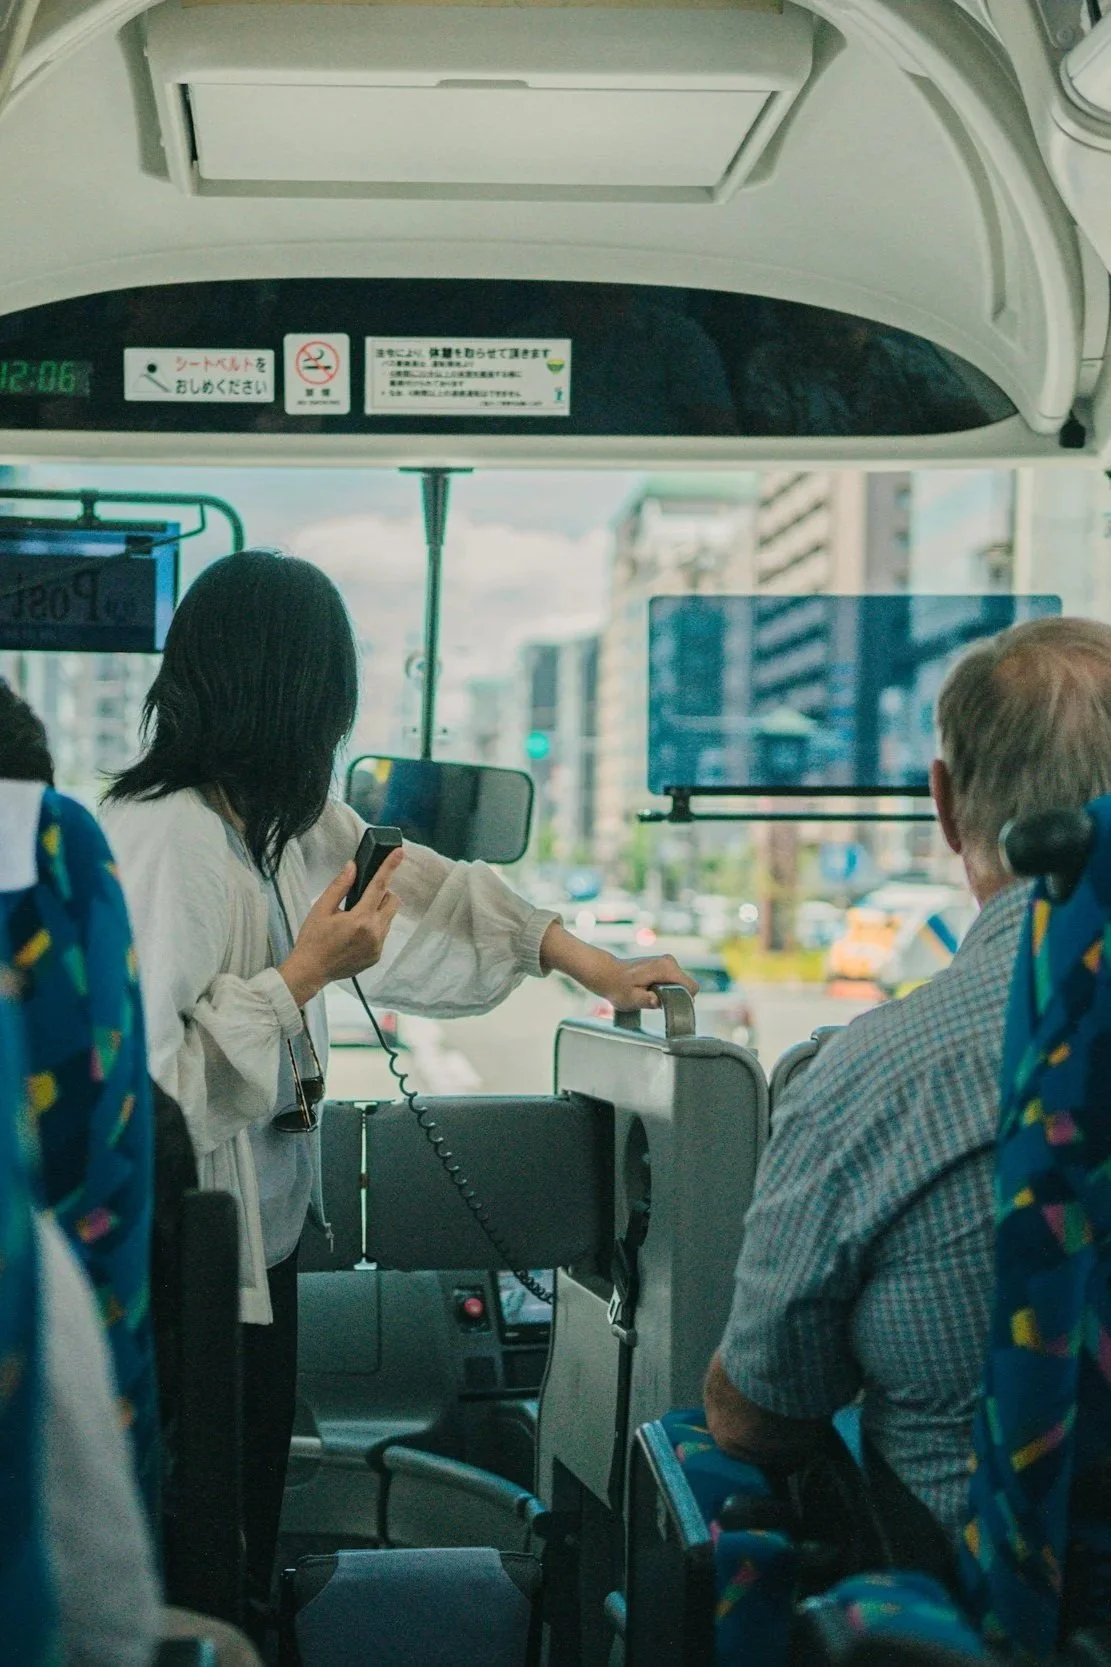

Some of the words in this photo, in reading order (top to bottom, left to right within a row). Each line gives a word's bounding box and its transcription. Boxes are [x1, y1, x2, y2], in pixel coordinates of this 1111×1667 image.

[175, 356, 266, 373] シートベルトを
[175, 379, 267, 395] おしめください
